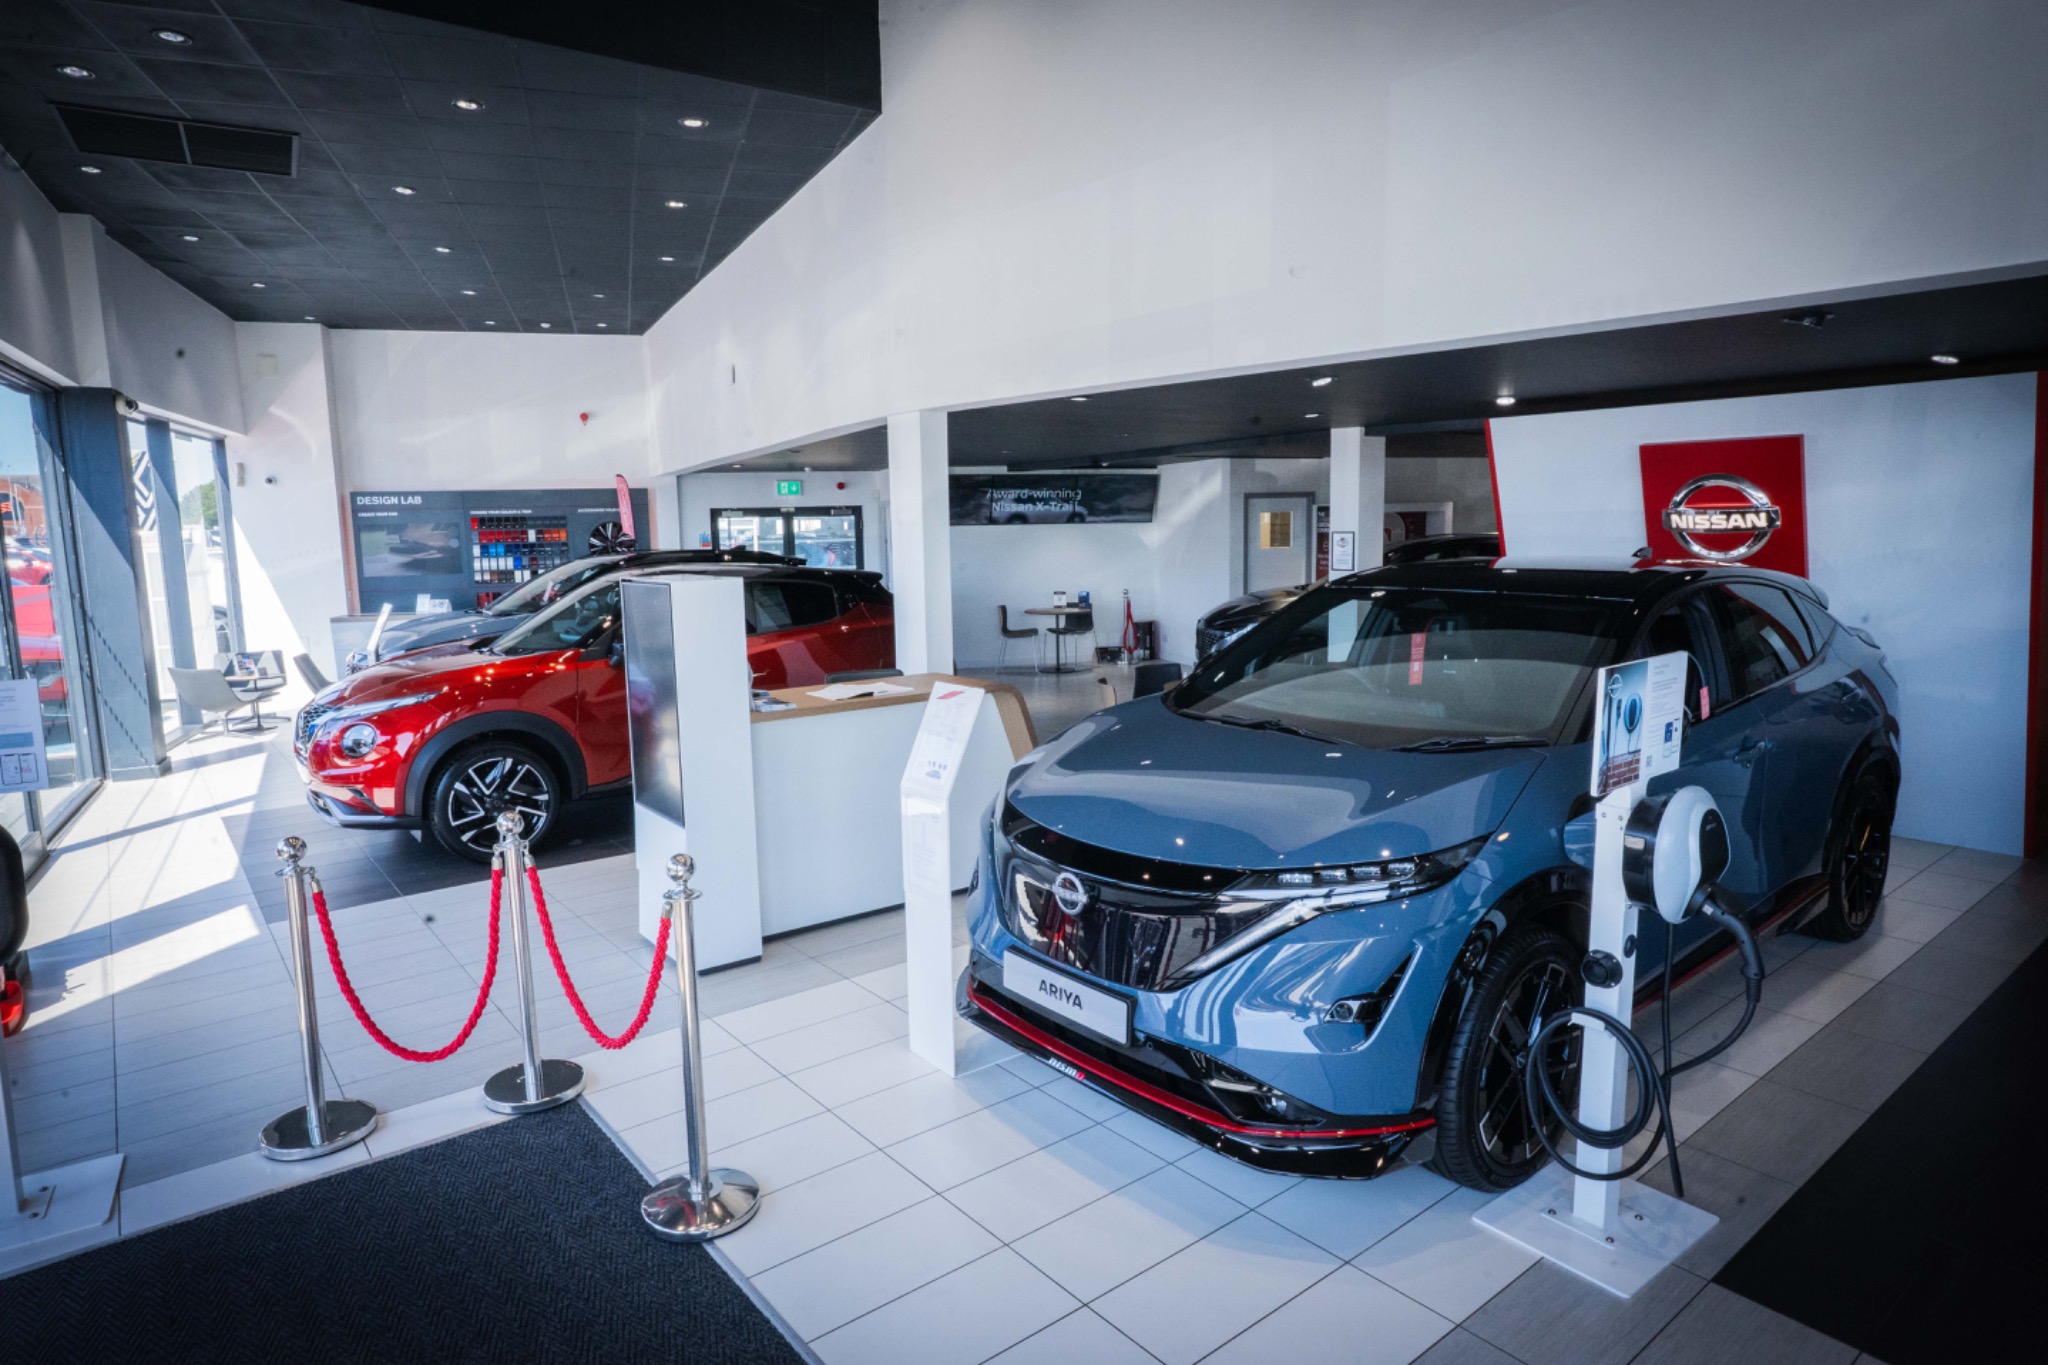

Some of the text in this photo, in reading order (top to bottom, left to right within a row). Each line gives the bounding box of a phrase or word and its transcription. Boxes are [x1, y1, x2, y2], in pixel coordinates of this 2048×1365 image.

[357, 496, 422, 505] DESIGN LAB
[986, 488, 1082, 501] Award-winning
[992, 501, 1078, 511] Nissan X-Trail
[1669, 512, 1768, 529] NISSAN
[1038, 979, 1083, 1010] ARIYA
[1048, 1057, 1085, 1081] nismo
